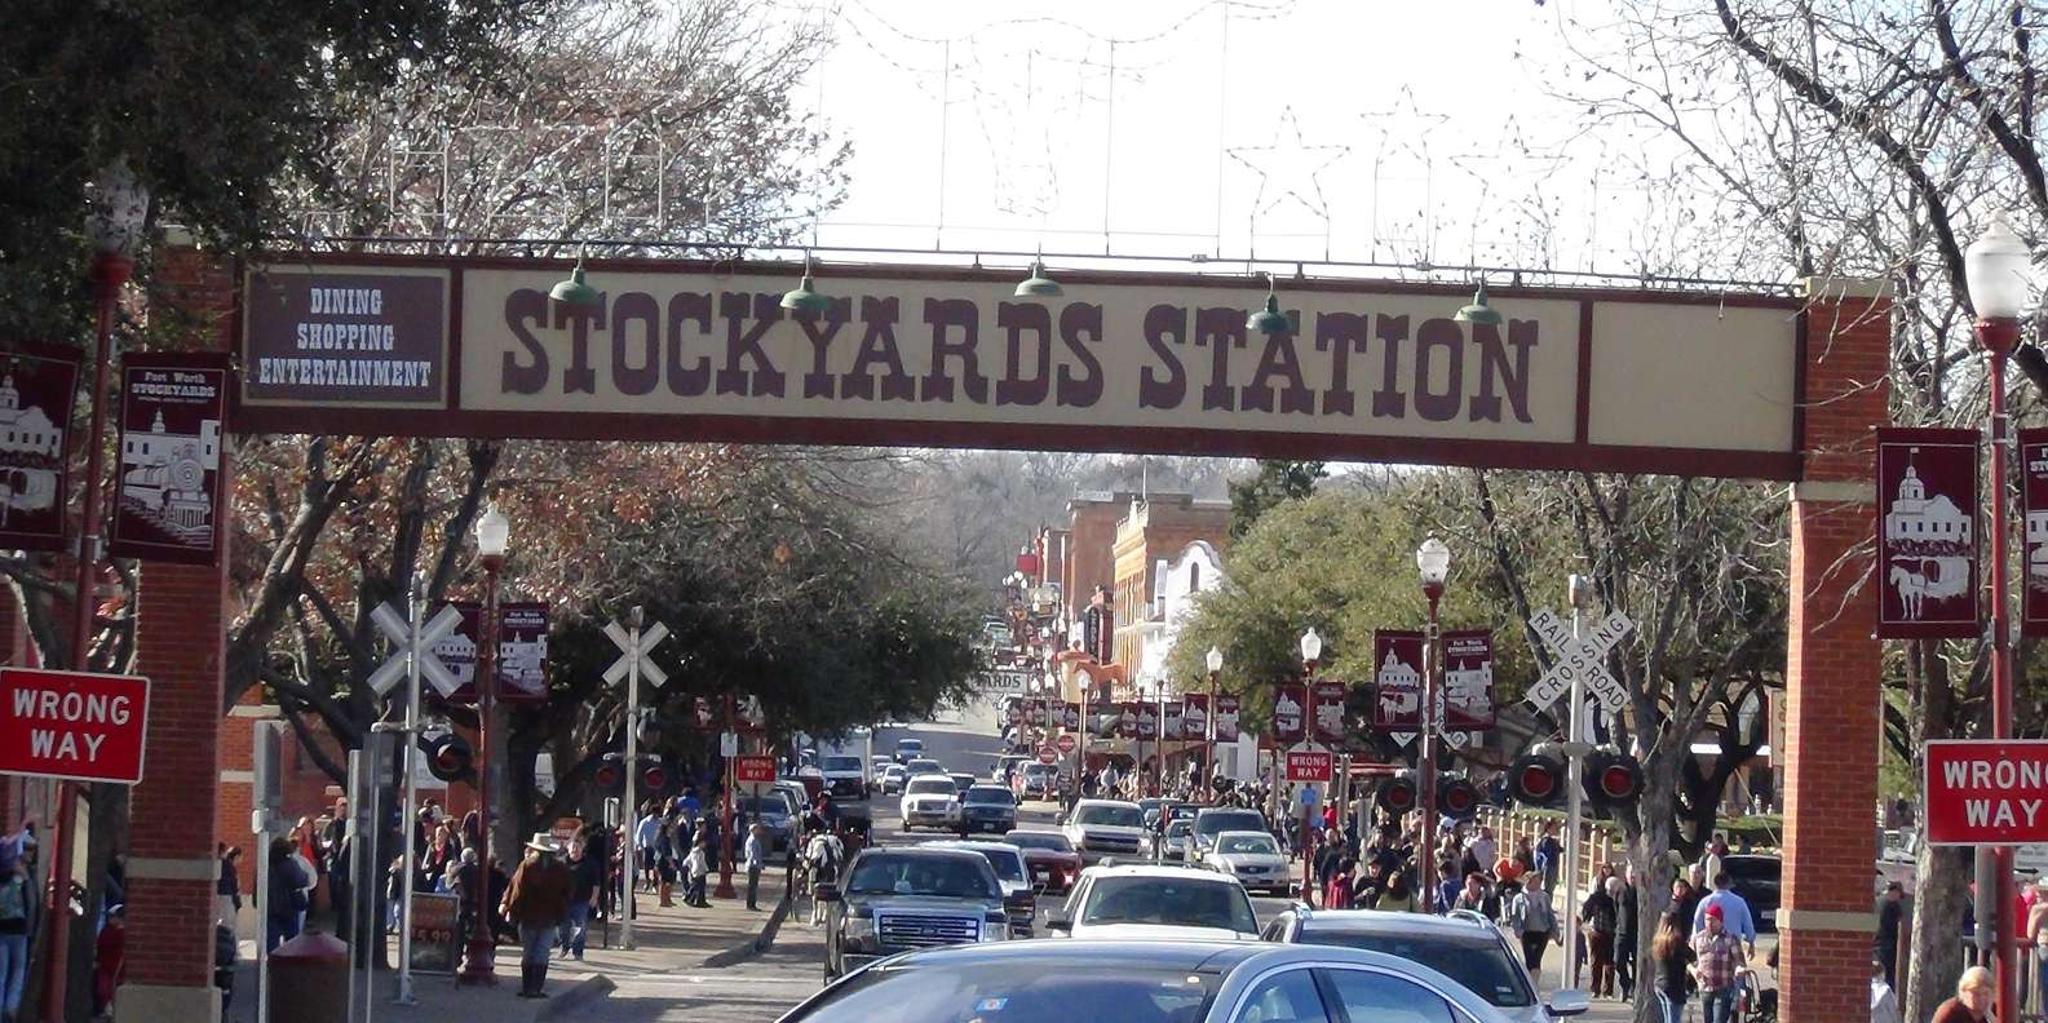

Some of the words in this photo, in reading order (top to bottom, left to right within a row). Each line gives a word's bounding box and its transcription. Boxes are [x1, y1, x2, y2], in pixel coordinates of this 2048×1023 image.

[310, 287, 383, 315] DINING
[297, 322, 394, 351] SHOPPING
[501, 289, 1105, 409] STOCKYARDS
[1138, 303, 1539, 424] STATION
[144, 371, 167, 382] Fort
[173, 372, 206, 384] Worth
[259, 358, 432, 387] ENTERTAINMENT
[131, 383, 216, 397] STOCKYARDS
[1534, 612, 1570, 653] RAIL
[1537, 618, 1624, 701] CROSSING
[1584, 666, 1625, 707] ROAD
[14, 688, 131, 726] WRONG
[31, 728, 107, 763] WAY
[1291, 755, 1328, 767] WRONG
[1297, 767, 1320, 778] WAY
[1942, 759, 2048, 790] WRON
[1964, 798, 2043, 828] WAY
